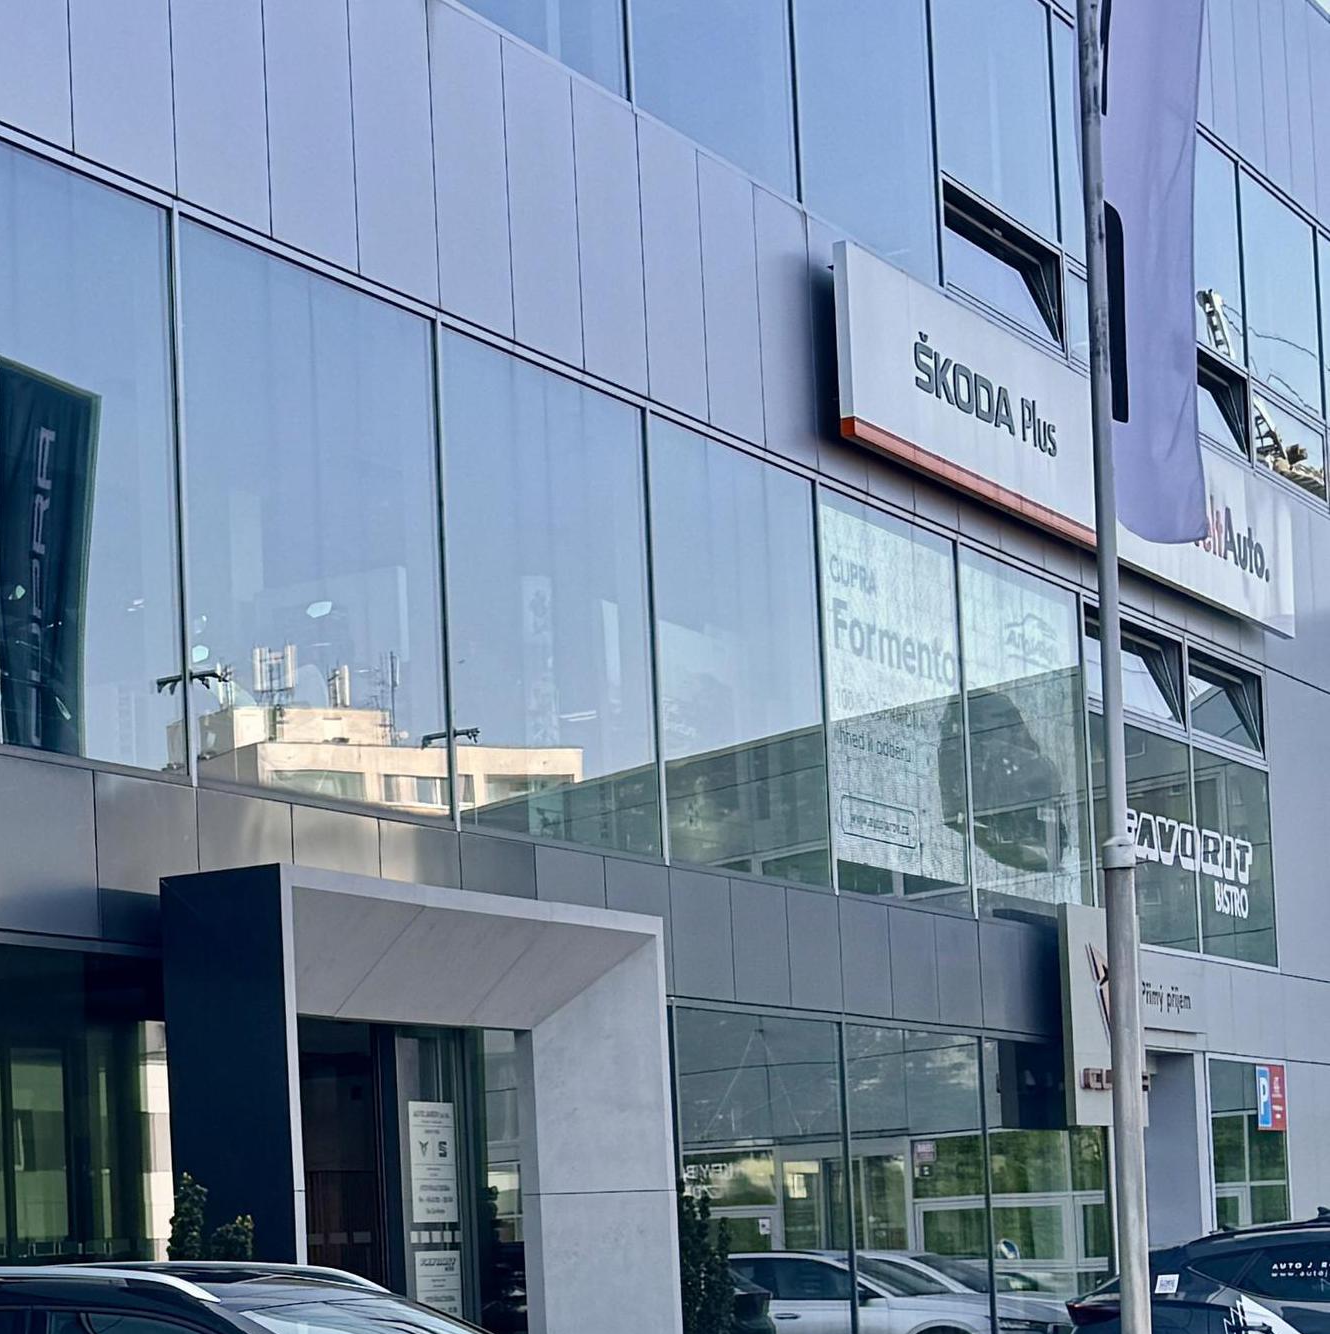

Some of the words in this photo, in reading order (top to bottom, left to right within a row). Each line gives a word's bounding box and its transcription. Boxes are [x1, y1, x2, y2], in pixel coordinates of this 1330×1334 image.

[914, 331, 1016, 436] ŠKODA
[1020, 397, 1057, 457] Plus
[1214, 880, 1249, 919] BISTRO
[1259, 1077, 1269, 1116] P
